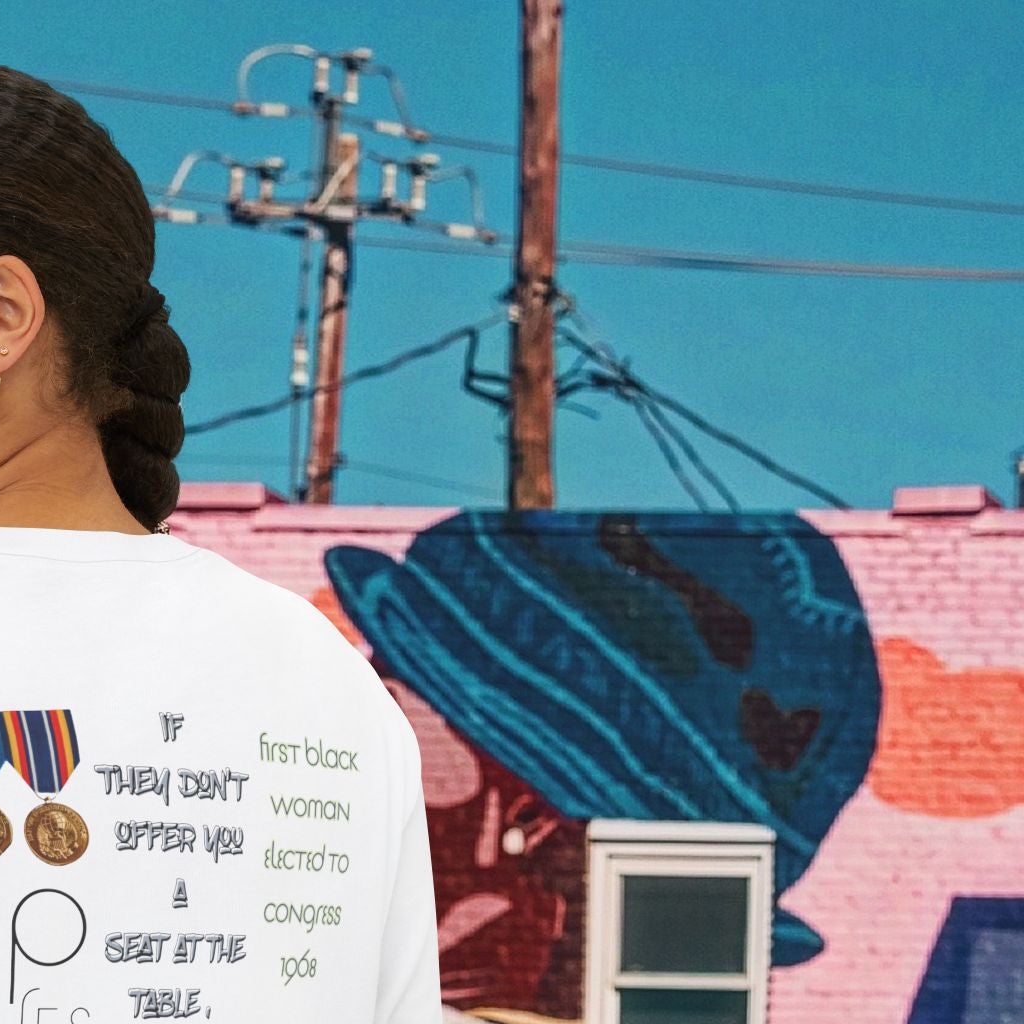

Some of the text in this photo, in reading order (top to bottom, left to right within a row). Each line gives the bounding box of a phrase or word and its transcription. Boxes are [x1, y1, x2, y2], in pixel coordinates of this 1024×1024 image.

[159, 711, 184, 743] IF
[93, 763, 250, 807] THEY DON'T
[113, 819, 197, 853] OFFER
[202, 824, 244, 863] YOU
[171, 877, 188, 909] A
[104, 931, 247, 964] SEAT AT THE
[280, 948, 317, 986] 1968
